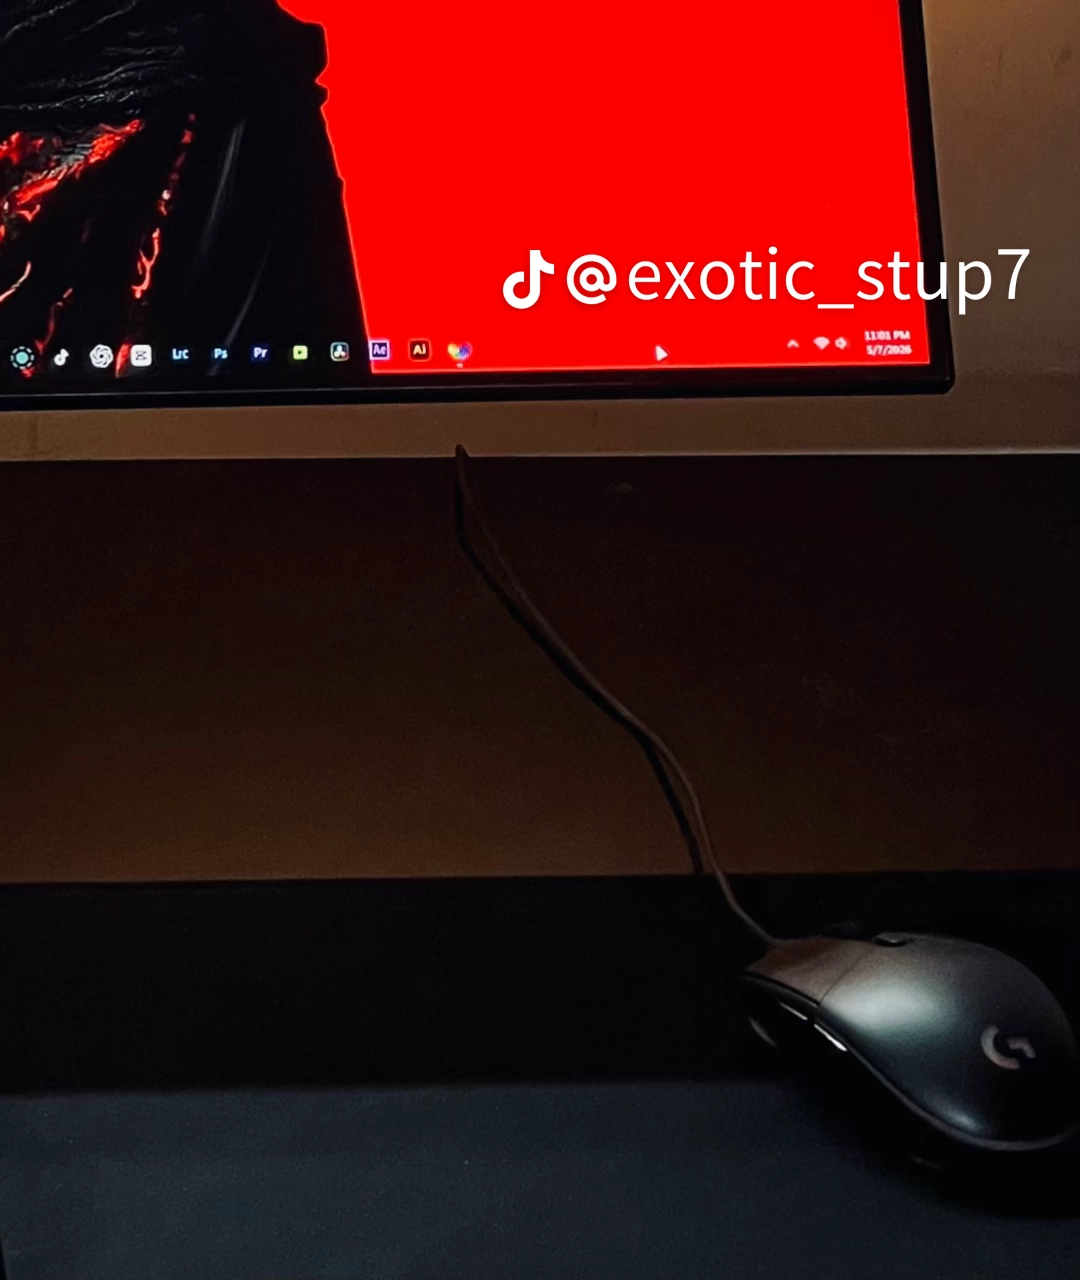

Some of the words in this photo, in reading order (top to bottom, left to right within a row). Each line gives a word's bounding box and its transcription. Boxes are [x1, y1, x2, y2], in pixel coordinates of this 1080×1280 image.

[892, 329, 911, 340] PM
[214, 348, 228, 359] Ps
[253, 347, 268, 358] Pr
[373, 344, 387, 355] Ae
